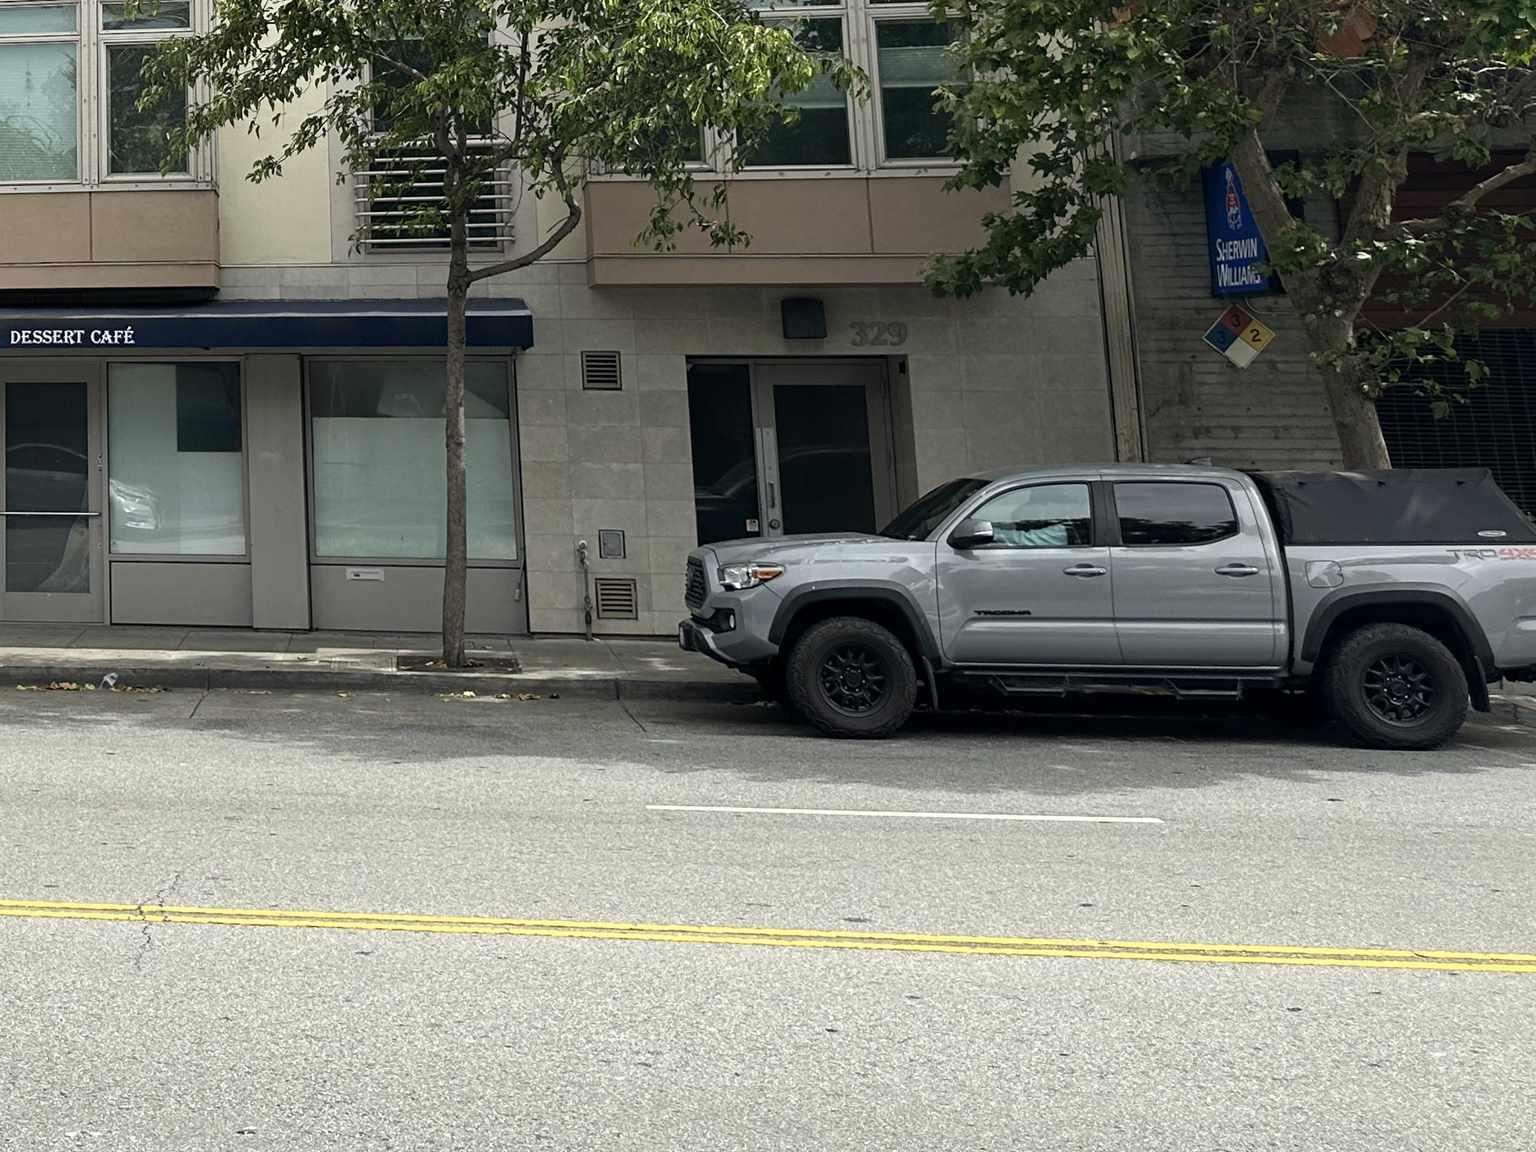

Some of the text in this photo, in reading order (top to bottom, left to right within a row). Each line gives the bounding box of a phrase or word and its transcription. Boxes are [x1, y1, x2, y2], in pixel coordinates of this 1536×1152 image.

[1216, 238, 1258, 261] SHERWIN
[1231, 314, 1241, 328] 3
[10, 330, 85, 344] DESSERT
[90, 326, 135, 344] CAFÉ
[849, 321, 907, 346] 329
[1250, 329, 1261, 342] 2
